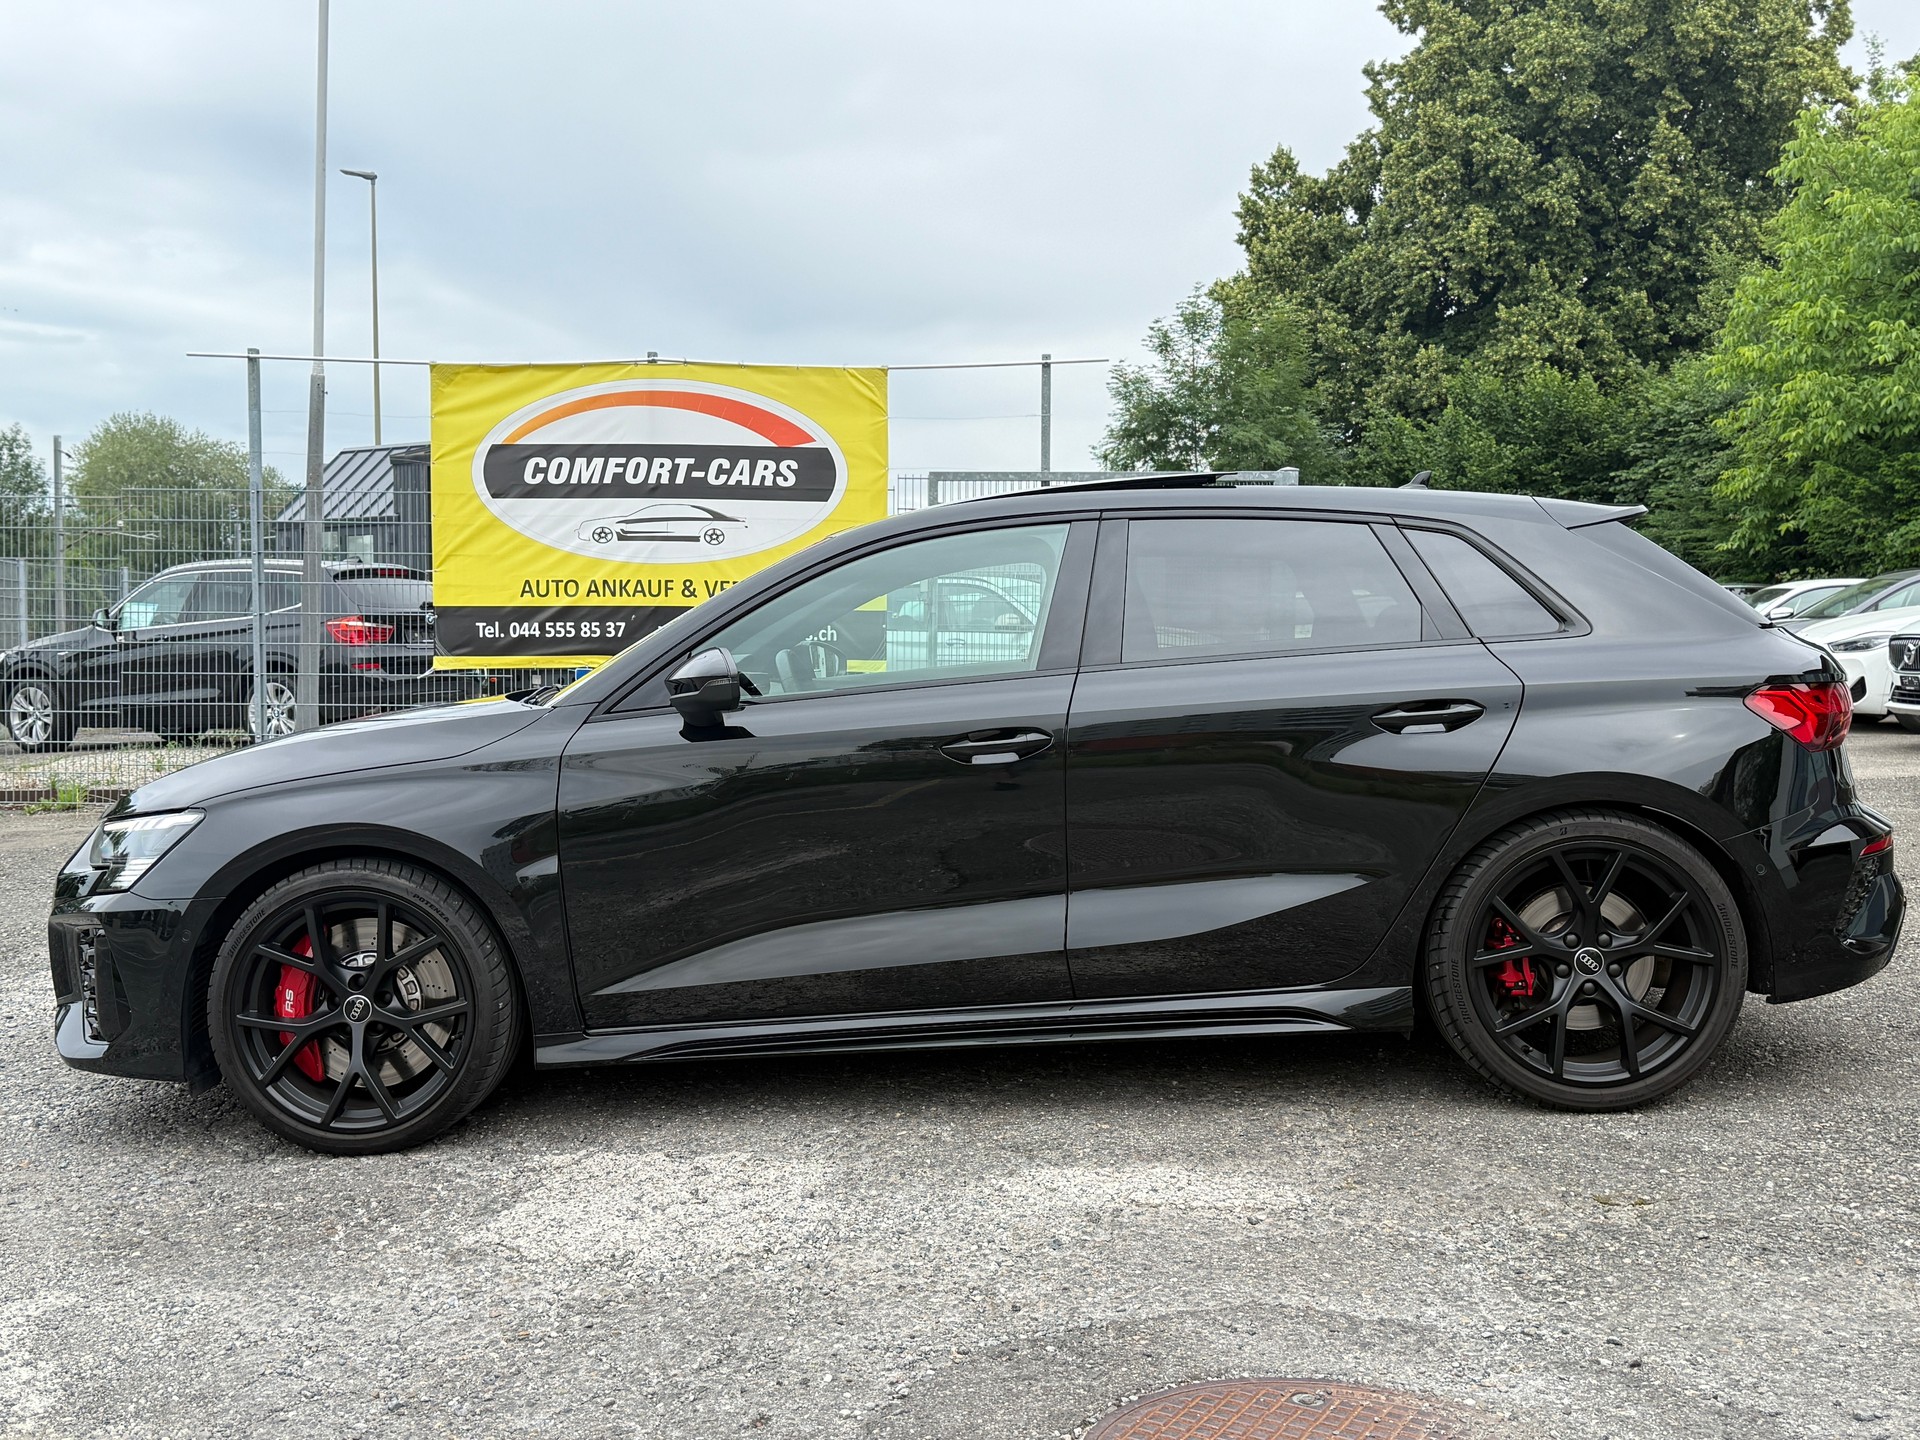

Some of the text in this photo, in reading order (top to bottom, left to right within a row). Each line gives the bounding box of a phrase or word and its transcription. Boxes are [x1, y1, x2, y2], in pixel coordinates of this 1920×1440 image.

[523, 456, 799, 488] COMFORT-CARS
[519, 578, 740, 599] AUTO ANKAUF & VE
[475, 621, 505, 638] Tel.
[509, 621, 541, 638] 044
[545, 621, 576, 638] 555
[580, 621, 601, 638] 85
[605, 621, 626, 638] 37
[412, 893, 450, 923] POTENZA
[227, 907, 266, 959] BRIDGESTONE
[1716, 903, 1739, 970] BRIDGESTONE
[285, 988, 295, 1013] RS
[1451, 958, 1473, 1024] BRIDGESTONE
